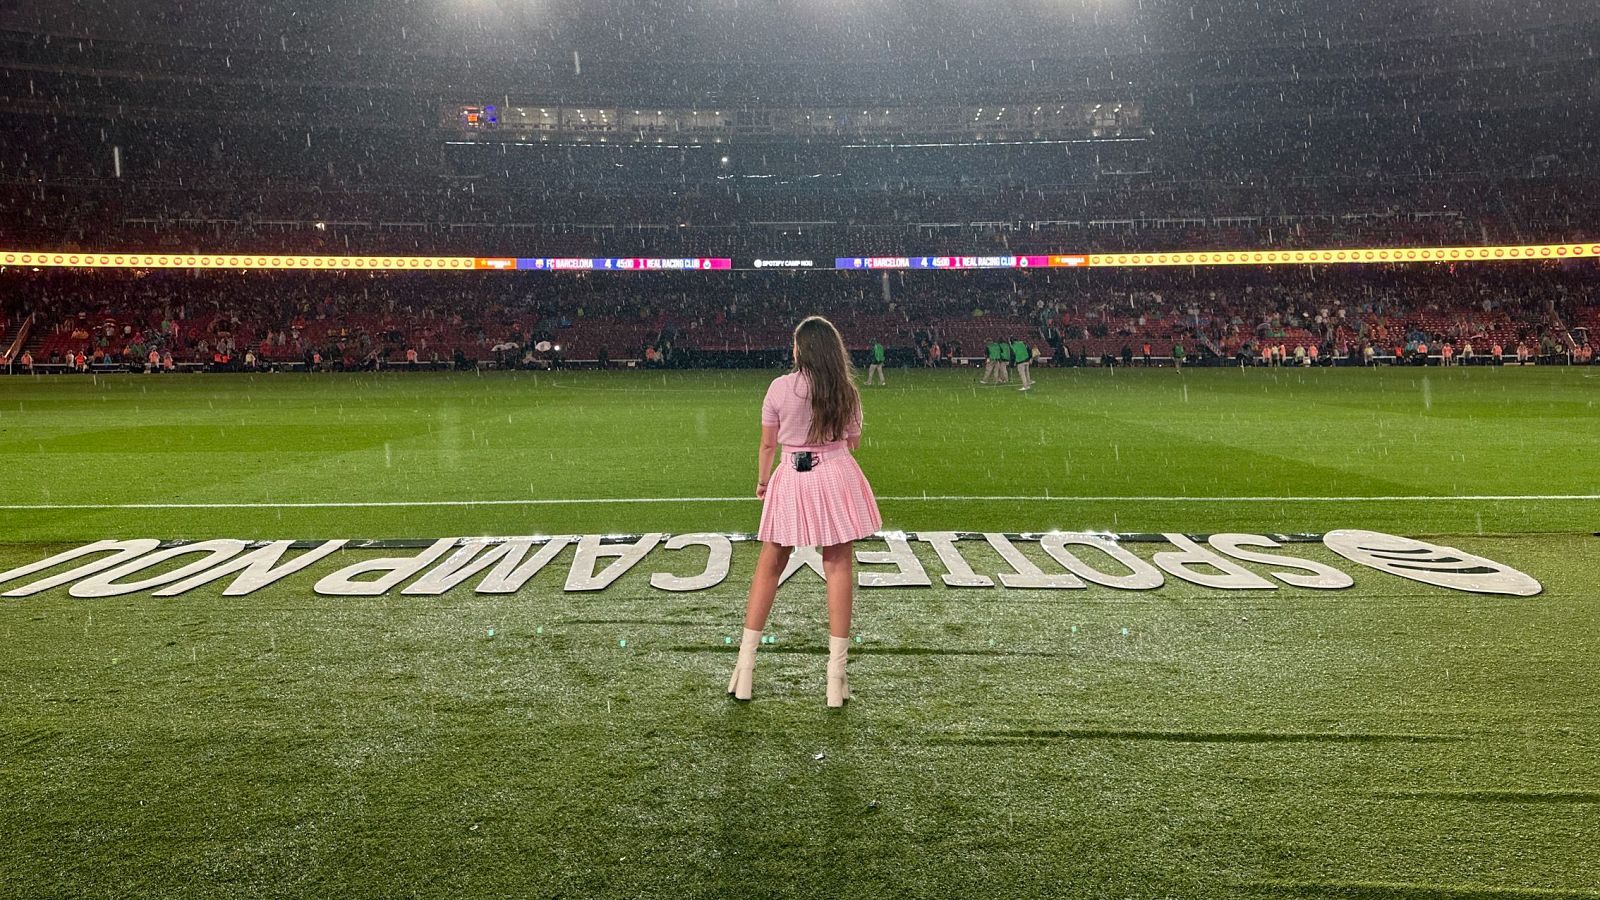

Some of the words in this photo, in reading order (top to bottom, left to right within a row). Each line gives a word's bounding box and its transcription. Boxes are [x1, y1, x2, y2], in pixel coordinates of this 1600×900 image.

[546, 258, 555, 268] FC
[556, 258, 593, 268] BARCELONA
[604, 258, 611, 268] 4
[646, 258, 661, 268] REAL
[662, 258, 683, 268] RACING
[685, 258, 700, 268] CLUB
[864, 257, 872, 267] FC
[873, 257, 910, 267] BARCELONA
[920, 257, 928, 267] 4
[962, 257, 977, 266] REAL
[978, 256, 1000, 266] RACING
[1001, 256, 1017, 266] CLUB
[0, 539, 349, 597] NOU
[313, 533, 732, 595] CAMP
